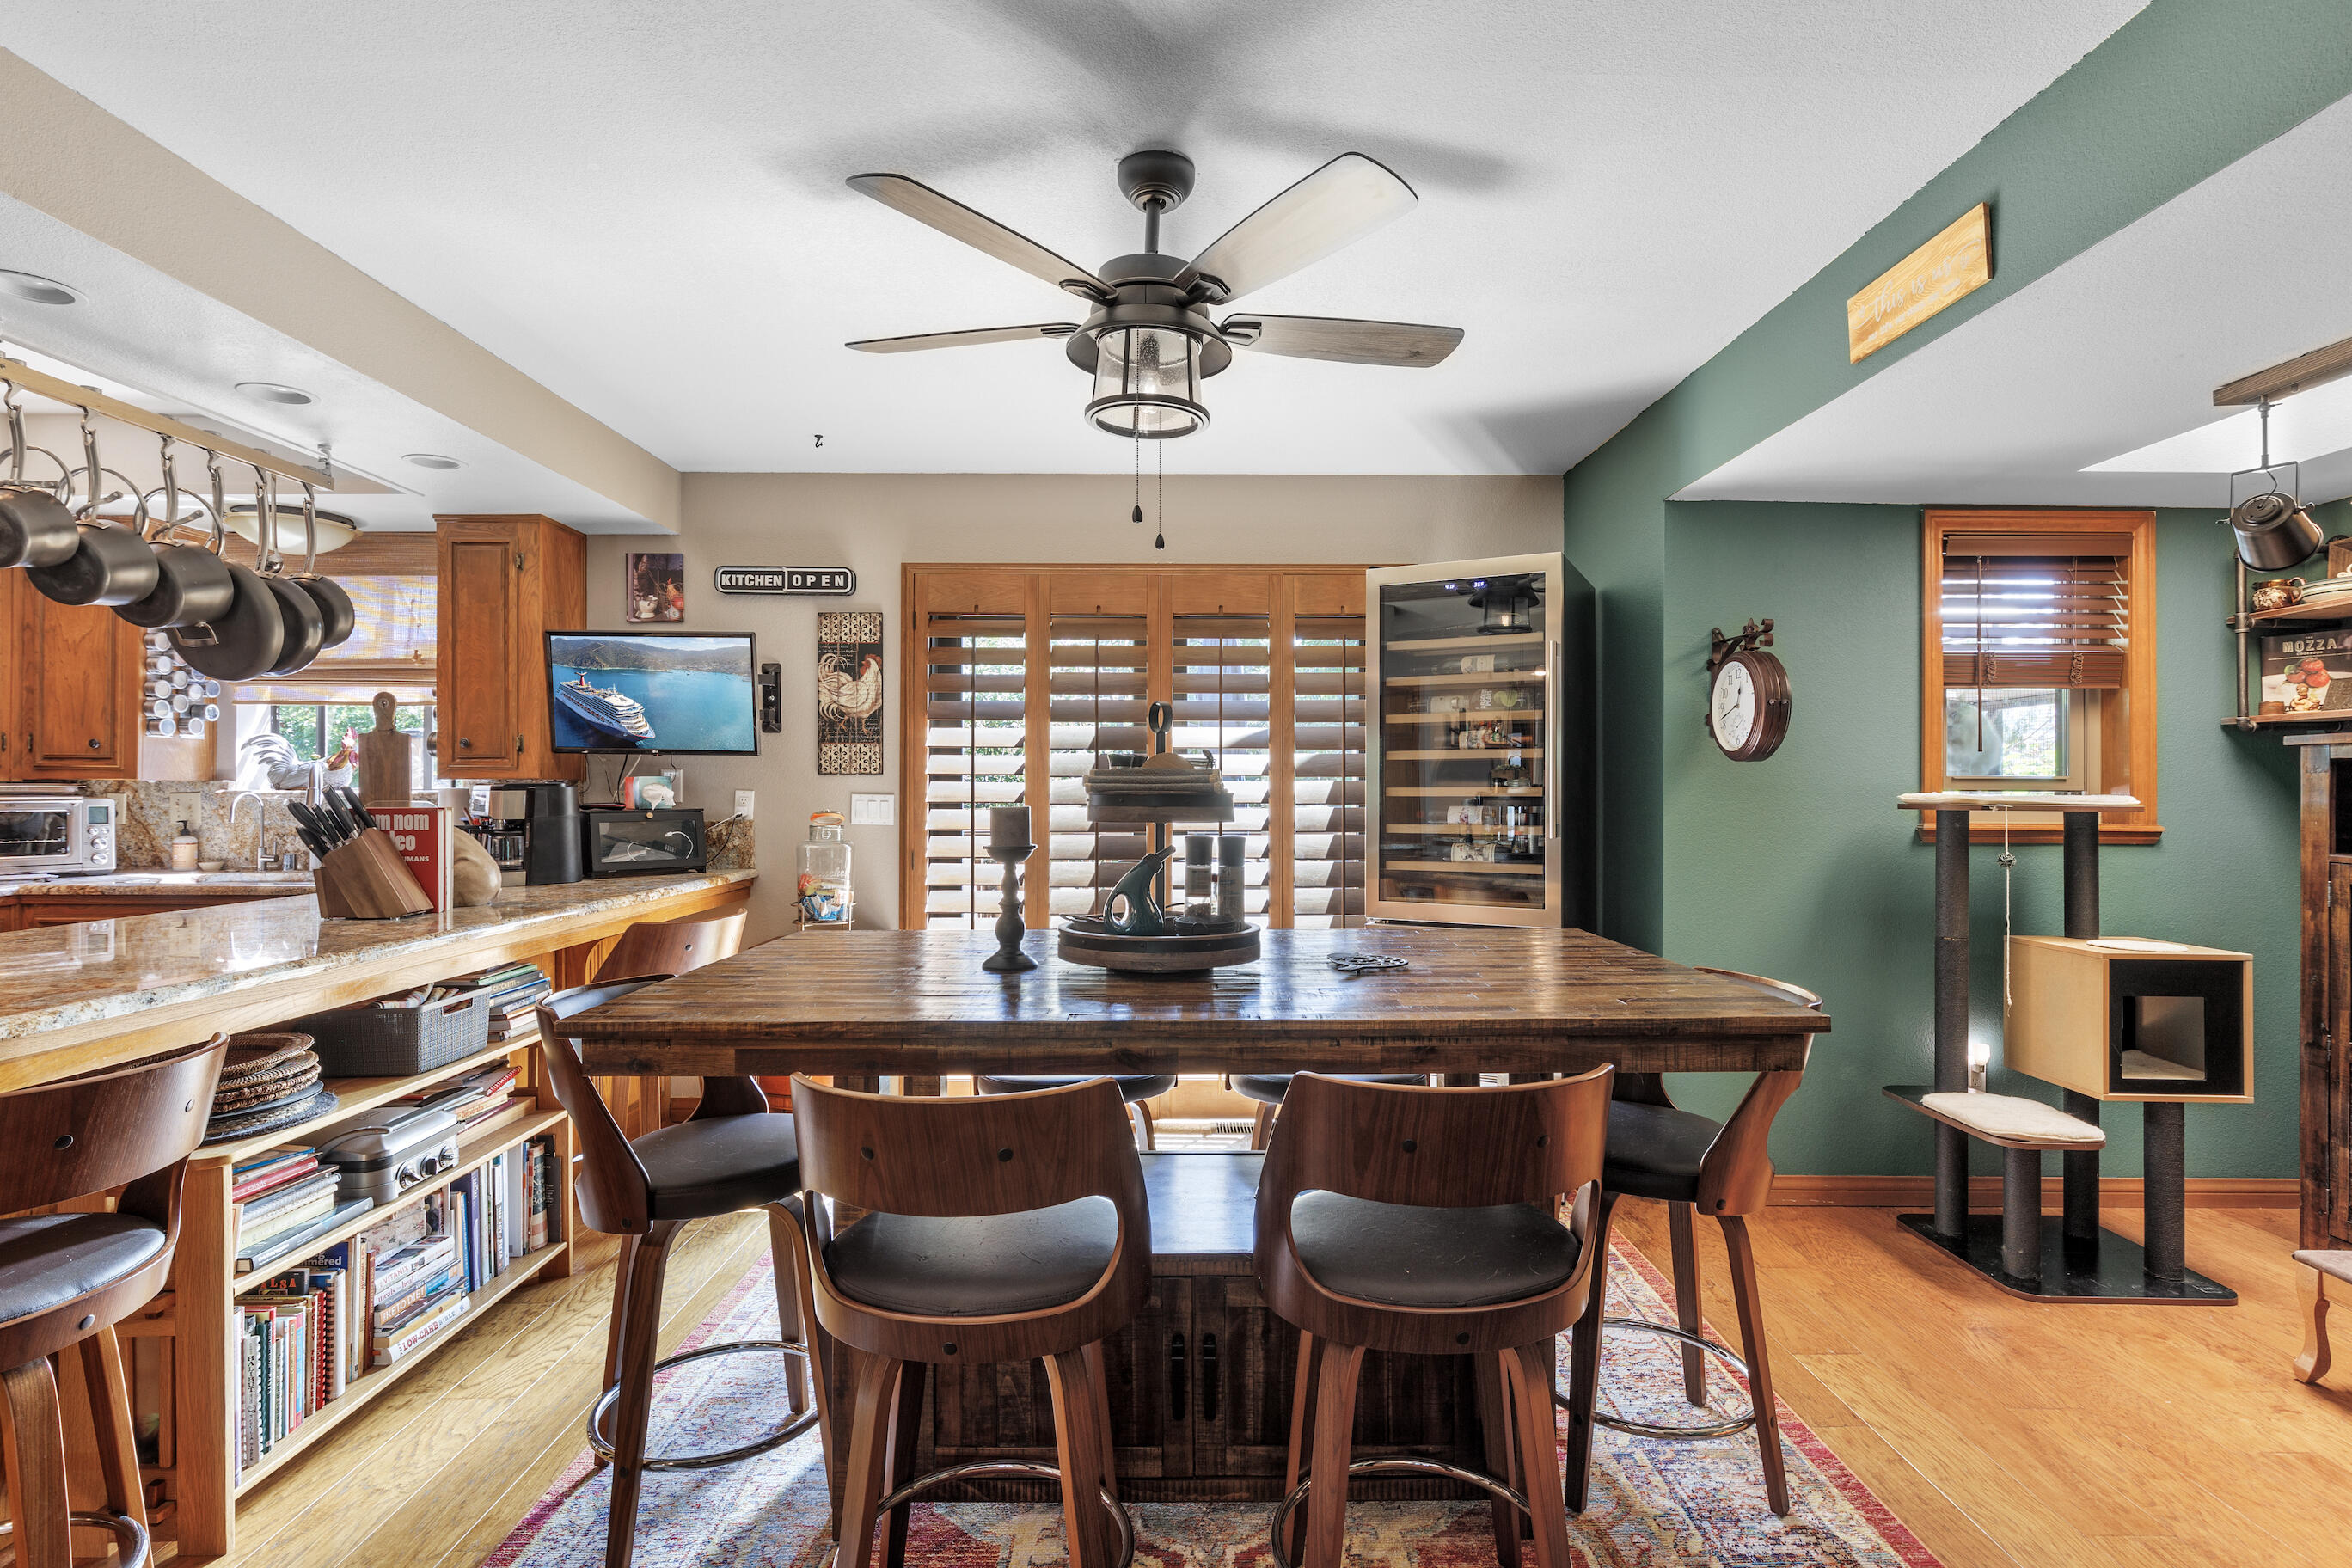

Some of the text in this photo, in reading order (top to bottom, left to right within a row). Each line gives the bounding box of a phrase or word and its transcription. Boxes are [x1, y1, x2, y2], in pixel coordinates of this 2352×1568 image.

[720, 573, 845, 587] KITCHEN OPEN
[2282, 638, 2337, 653] MOZZA
[393, 813, 430, 831] nom
[389, 830, 416, 851] leo
[301, 1256, 342, 1266] mered
[260, 1277, 297, 1289] ALSA
[383, 1265, 409, 1284] VITAMIX
[385, 1299, 407, 1321] KETO
[407, 1288, 426, 1306] DIET
[402, 1320, 439, 1351] LOW-CARB
